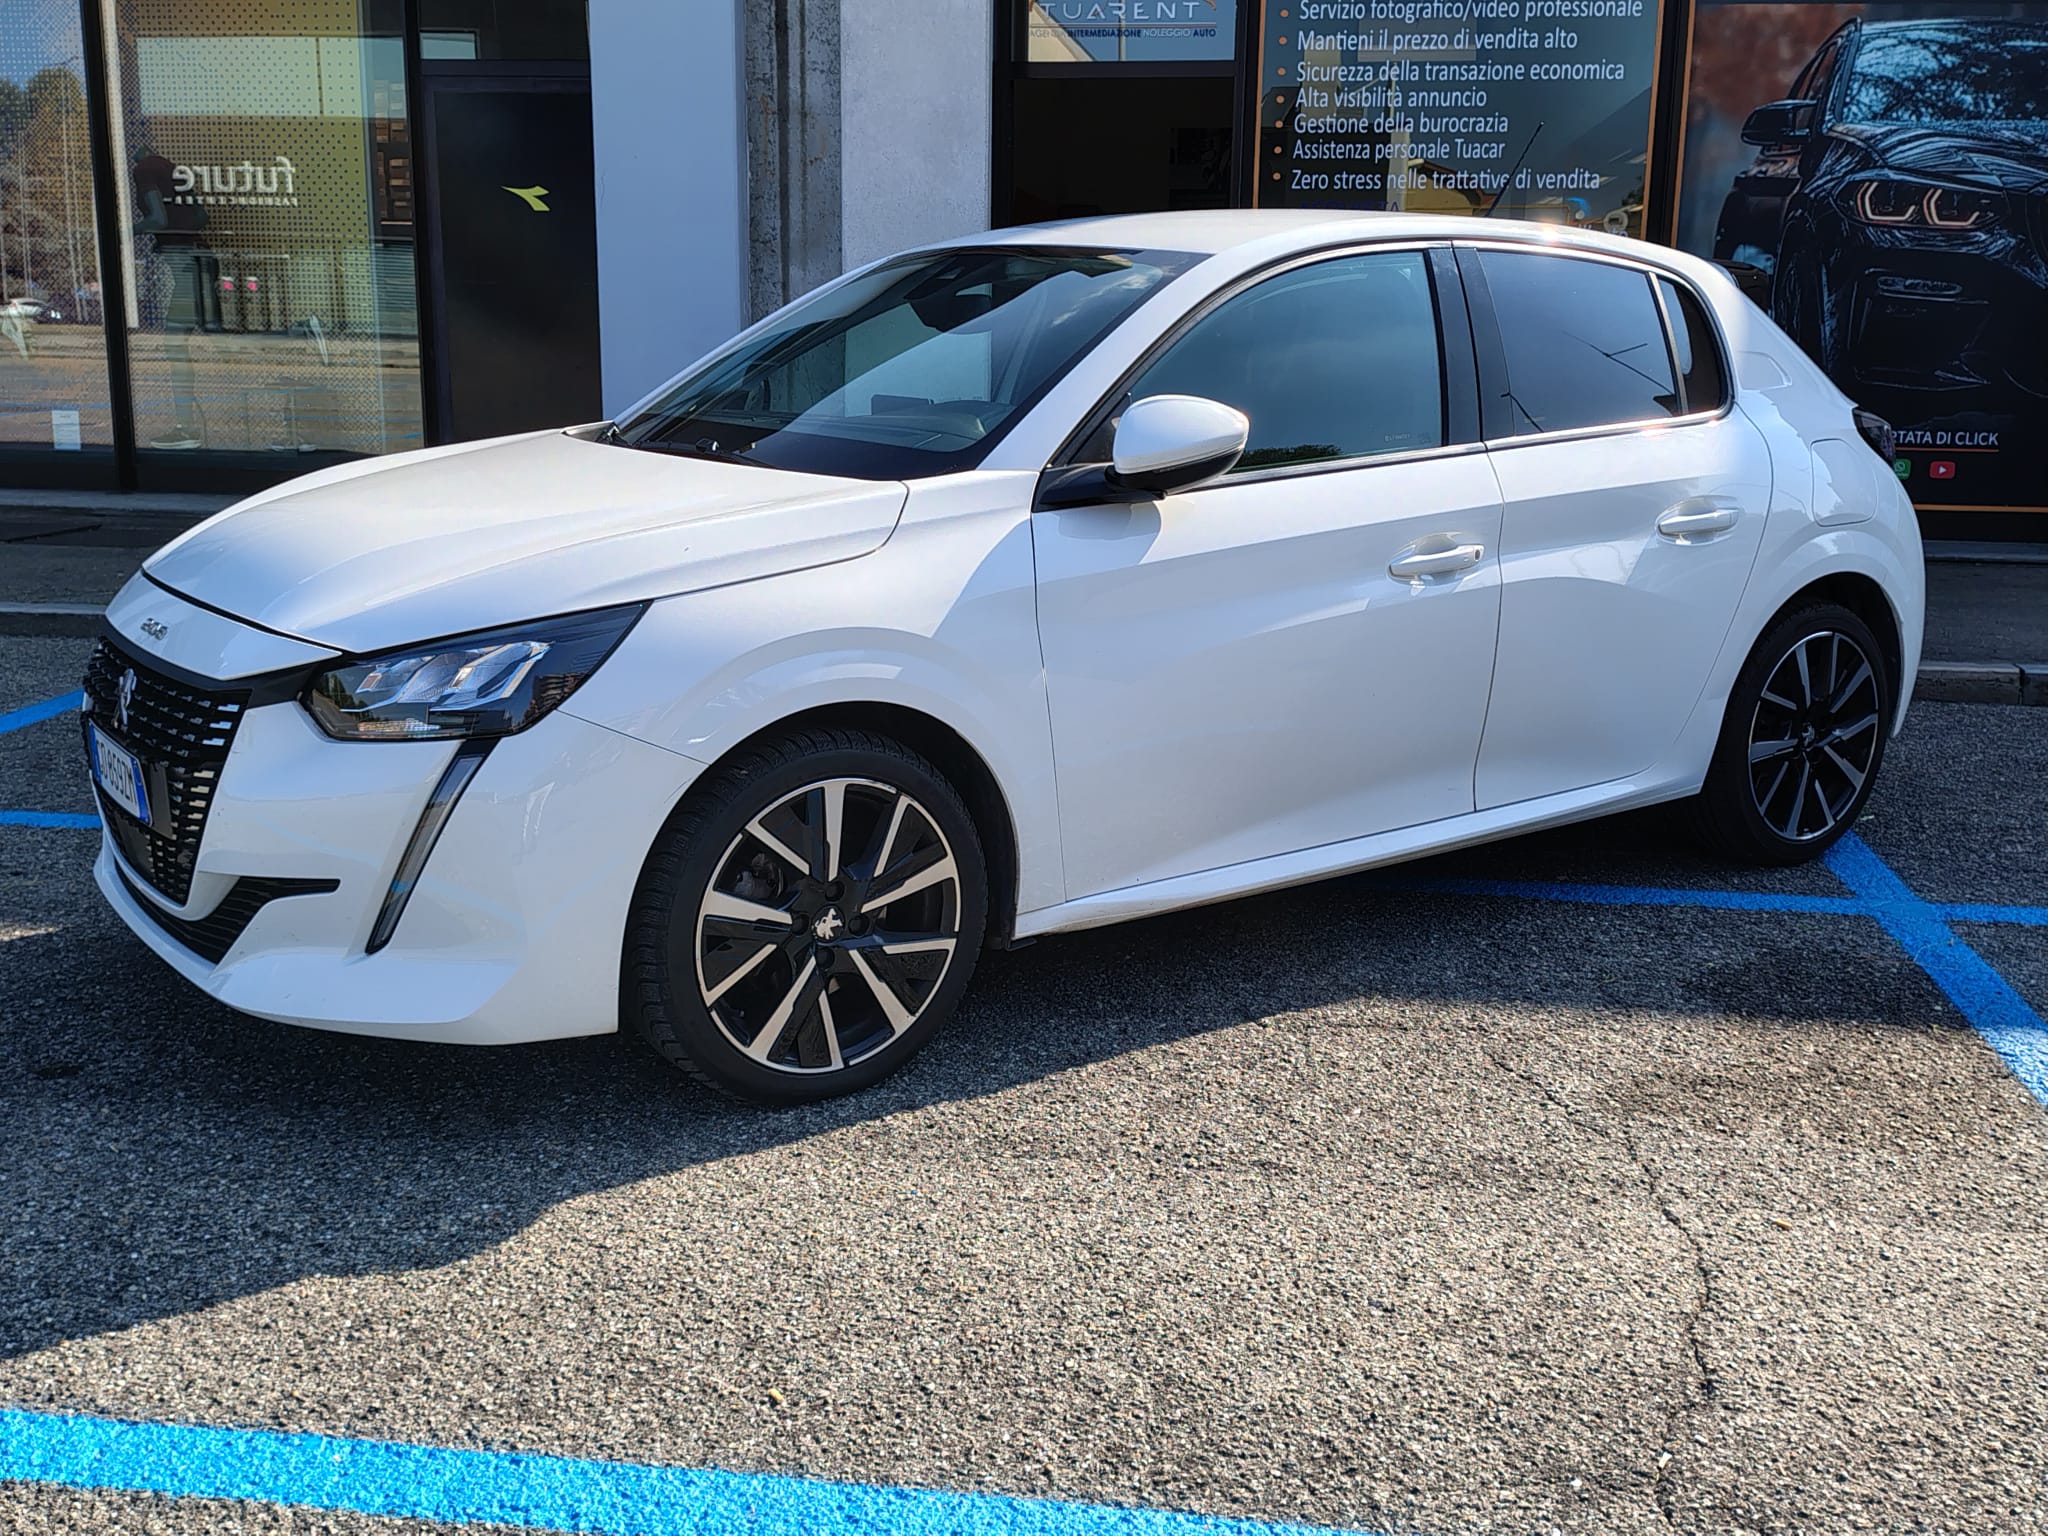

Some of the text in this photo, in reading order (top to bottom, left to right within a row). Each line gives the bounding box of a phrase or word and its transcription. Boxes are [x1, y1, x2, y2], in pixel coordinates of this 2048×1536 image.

[1040, 1, 1200, 20] TUARENT
[1299, 0, 1643, 24] Servizio fotografico/video professionale
[1143, 28, 1191, 38] NOLEGGIO
[1193, 28, 1217, 38] AUTO
[1298, 26, 1578, 55] Mantieni il prezzo di vendita alto
[1296, 58, 1625, 82] Sicurezza della transazione economica
[1295, 86, 1487, 107] Alta visibilità annuncio
[1294, 112, 1509, 134] Gestione della burocrazia
[1293, 137, 1505, 164] Assistenza personale Tuacar
[1291, 167, 1600, 190] Zero stress nelle trattative di vendita
[1936, 432, 1951, 445] DI
[1955, 432, 1999, 446] CLICK
